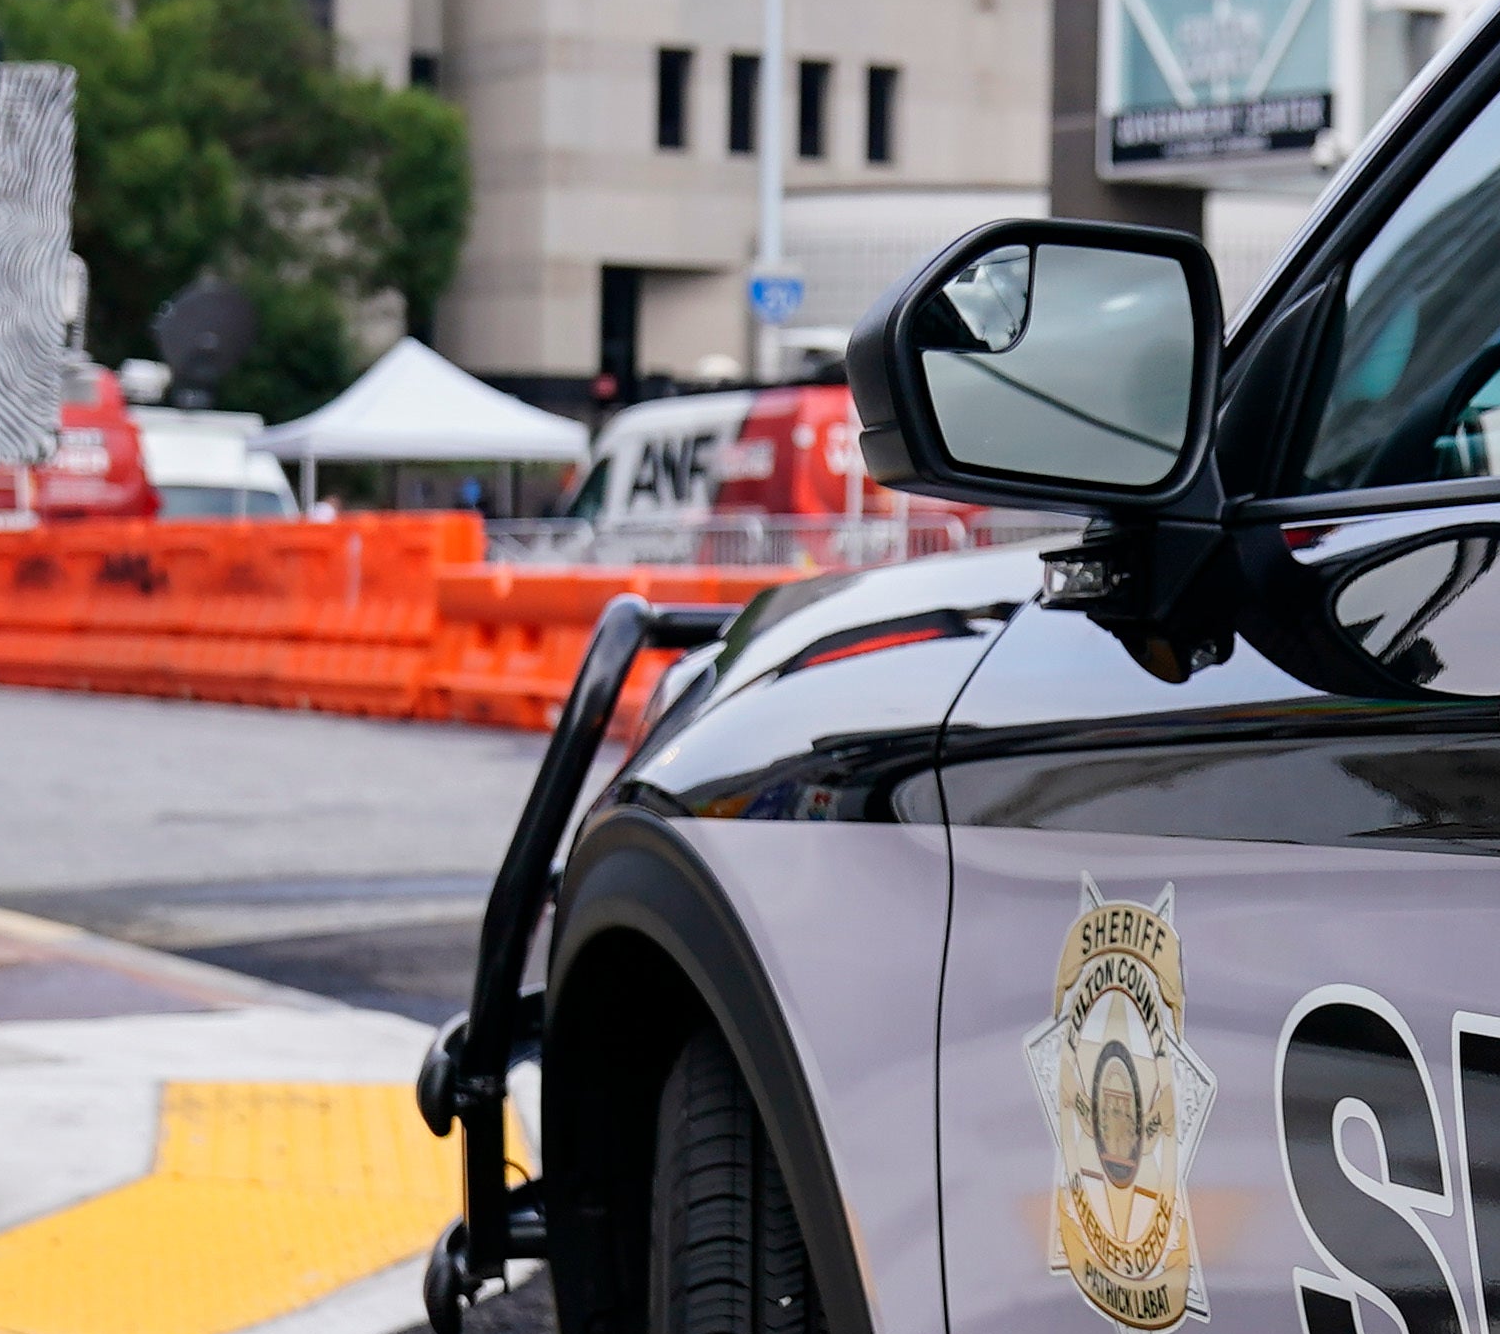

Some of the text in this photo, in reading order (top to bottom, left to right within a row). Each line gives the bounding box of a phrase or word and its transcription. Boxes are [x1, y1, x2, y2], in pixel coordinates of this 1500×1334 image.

[1082, 909, 1166, 960] SHERIFF
[1068, 957, 1166, 1057] FULTON COUNTY
[1071, 1171, 1172, 1275] SHERIFF'S OFFICE
[1085, 1258, 1171, 1319] PATRICK LABAT
